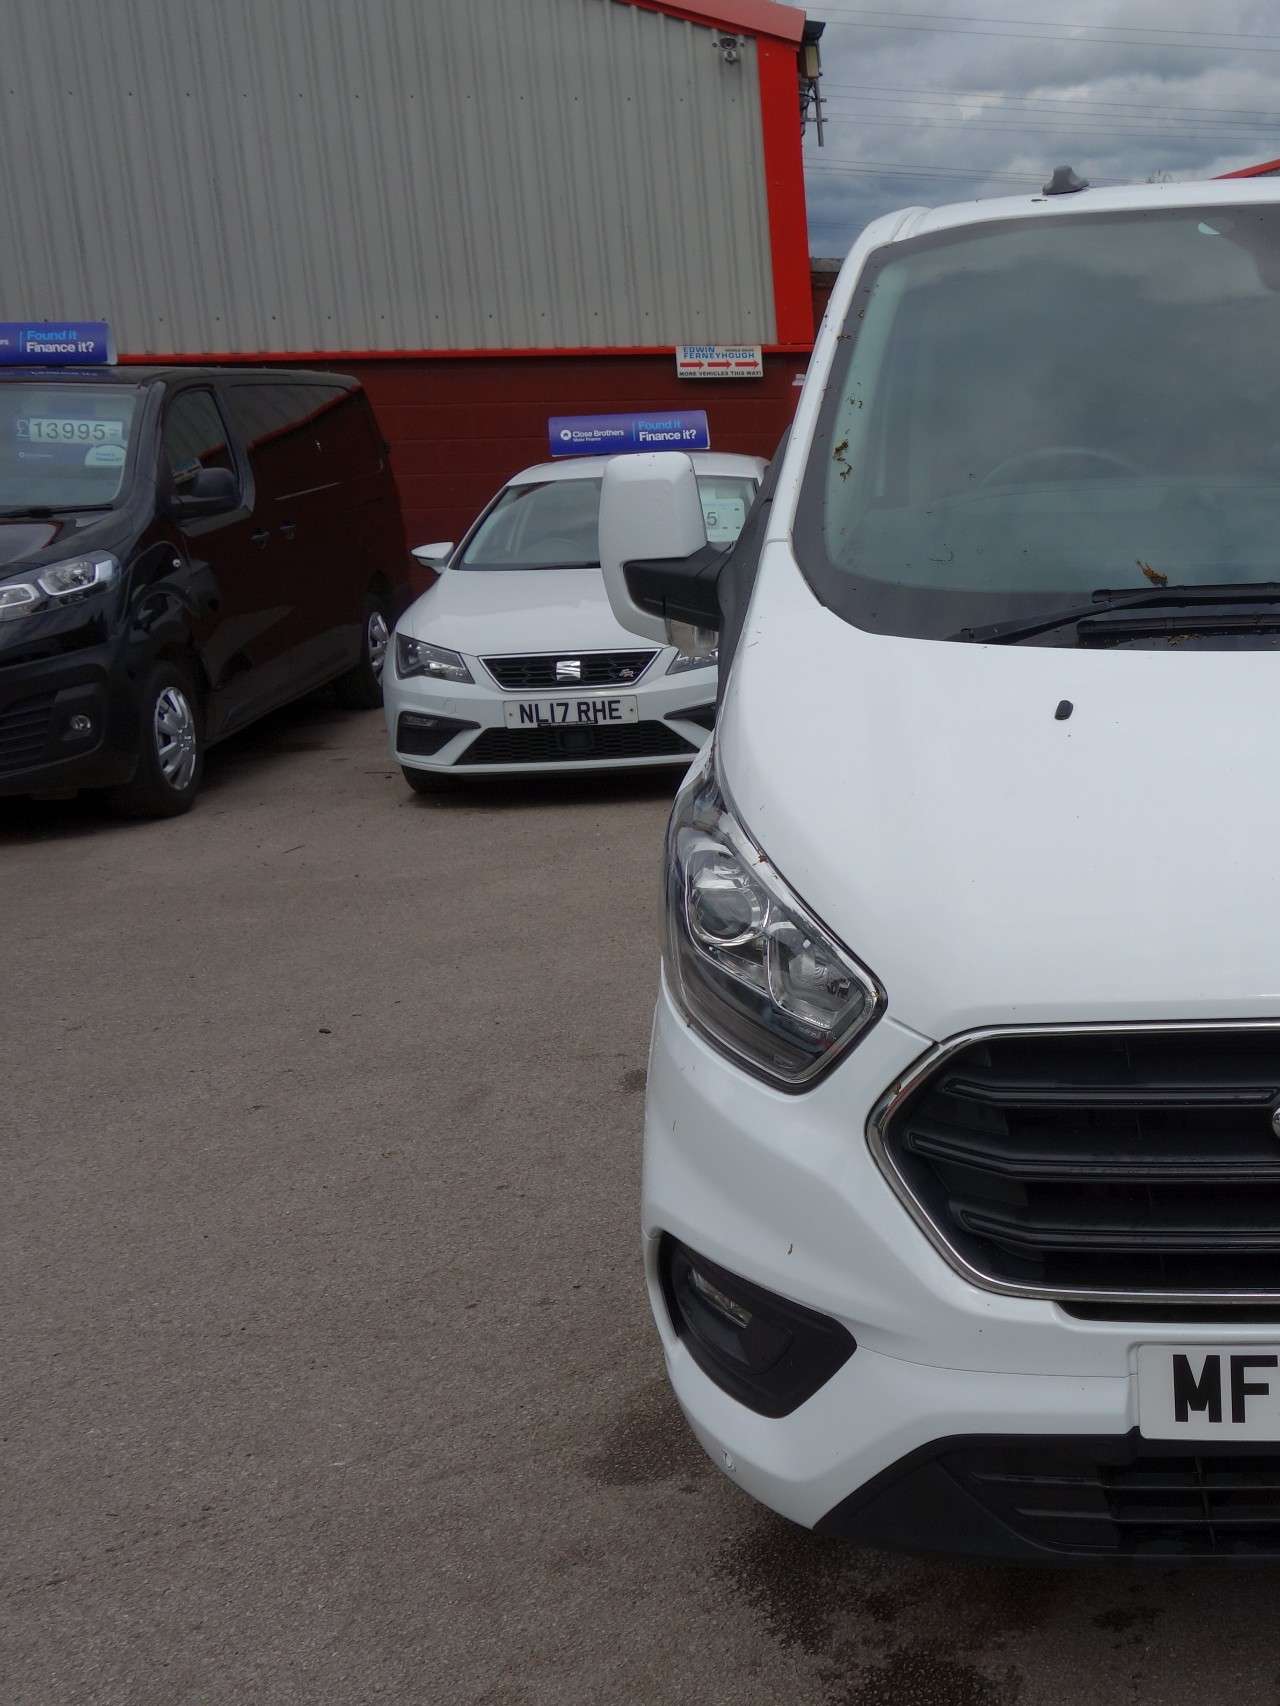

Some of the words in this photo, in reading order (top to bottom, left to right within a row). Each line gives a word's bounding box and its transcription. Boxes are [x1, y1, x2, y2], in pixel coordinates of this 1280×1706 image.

[27, 330, 65, 339] Found
[26, 341, 75, 353] Finance
[78, 341, 95, 353] it?
[638, 420, 672, 430] Found
[573, 430, 593, 438] Close
[594, 429, 624, 437] Brothers
[639, 431, 681, 441] Finance
[683, 429, 697, 440] it?
[519, 702, 569, 724] NL17
[577, 700, 622, 723] RHE
